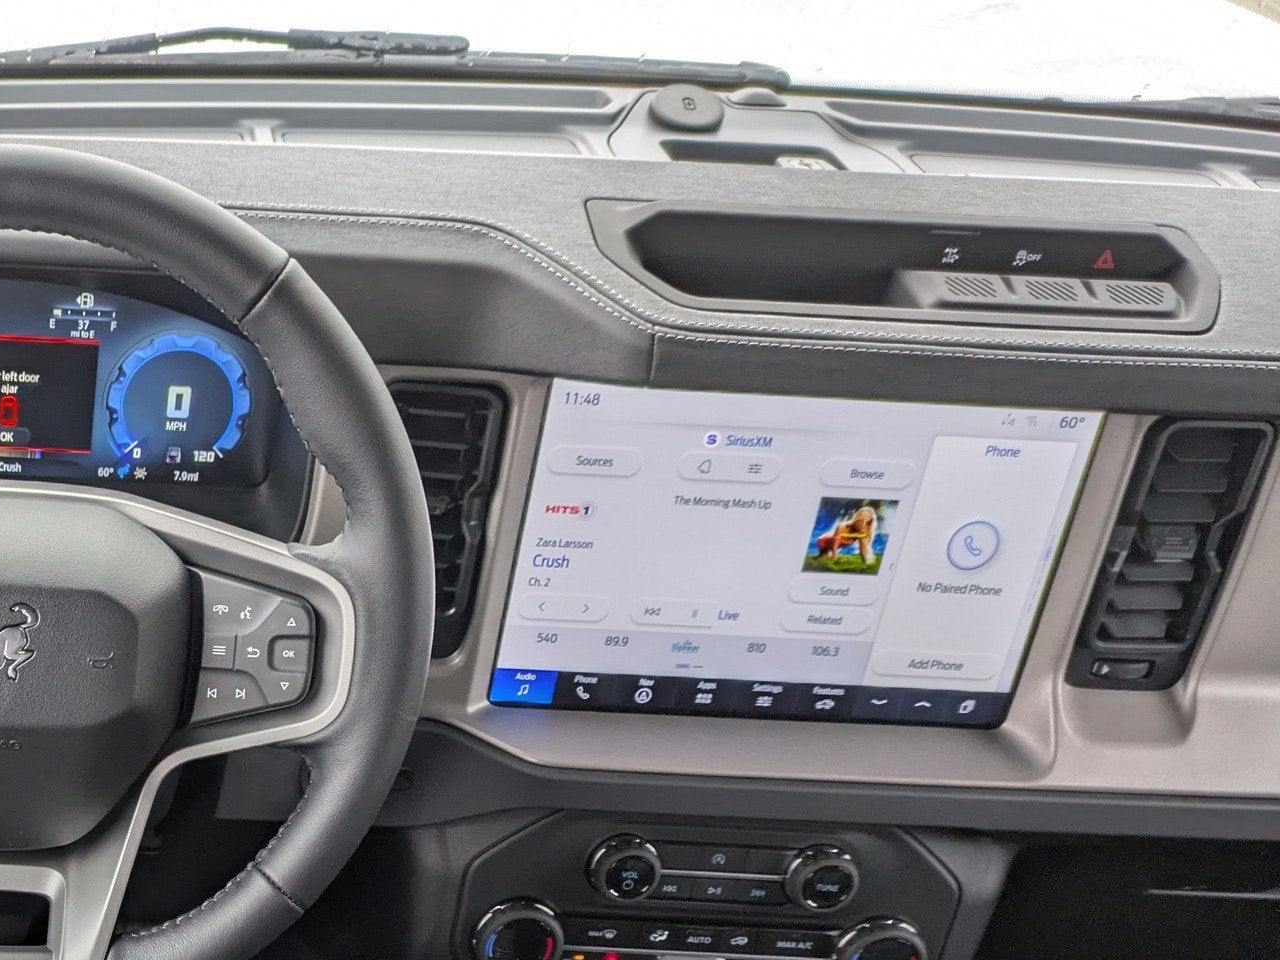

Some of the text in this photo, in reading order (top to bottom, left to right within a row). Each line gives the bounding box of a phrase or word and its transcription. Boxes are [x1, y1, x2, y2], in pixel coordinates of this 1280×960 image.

[1026, 253, 1042, 262] OFF
[49, 319, 56, 329] E
[77, 320, 89, 330] 37
[111, 321, 117, 332] F
[81, 330, 89, 338] to
[2, 370, 18, 382] left
[18, 371, 40, 383] door
[1, 384, 18, 395] ajar
[166, 385, 192, 419] 0
[563, 392, 601, 406] 11:48
[165, 421, 187, 432] MPH
[0, 432, 14, 443] OK
[725, 435, 773, 448] SiriusXM
[132, 447, 141, 459] 0
[193, 450, 215, 463] 120
[985, 445, 1020, 458] Phone
[575, 455, 614, 467] Sources
[850, 469, 884, 481] Browse
[674, 495, 772, 511] The Morning Mash Up
[545, 505, 591, 515] HITS 1
[535, 537, 594, 549] Zara Larsson
[532, 554, 570, 569] Crush
[528, 577, 551, 587] Ch. 2
[819, 586, 850, 597] Sound
[917, 582, 1002, 596] No Paired Phone
[717, 610, 740, 622] Live
[806, 615, 843, 626] Related
[536, 632, 558, 644] 540
[604, 636, 629, 648] 89.9
[282, 650, 295, 658] OK
[908, 659, 964, 672] Add Phone
[515, 672, 536, 681] Audio
[574, 675, 598, 685] Phone
[622, 871, 639, 879] VOL
[687, 936, 712, 944] AUTO
